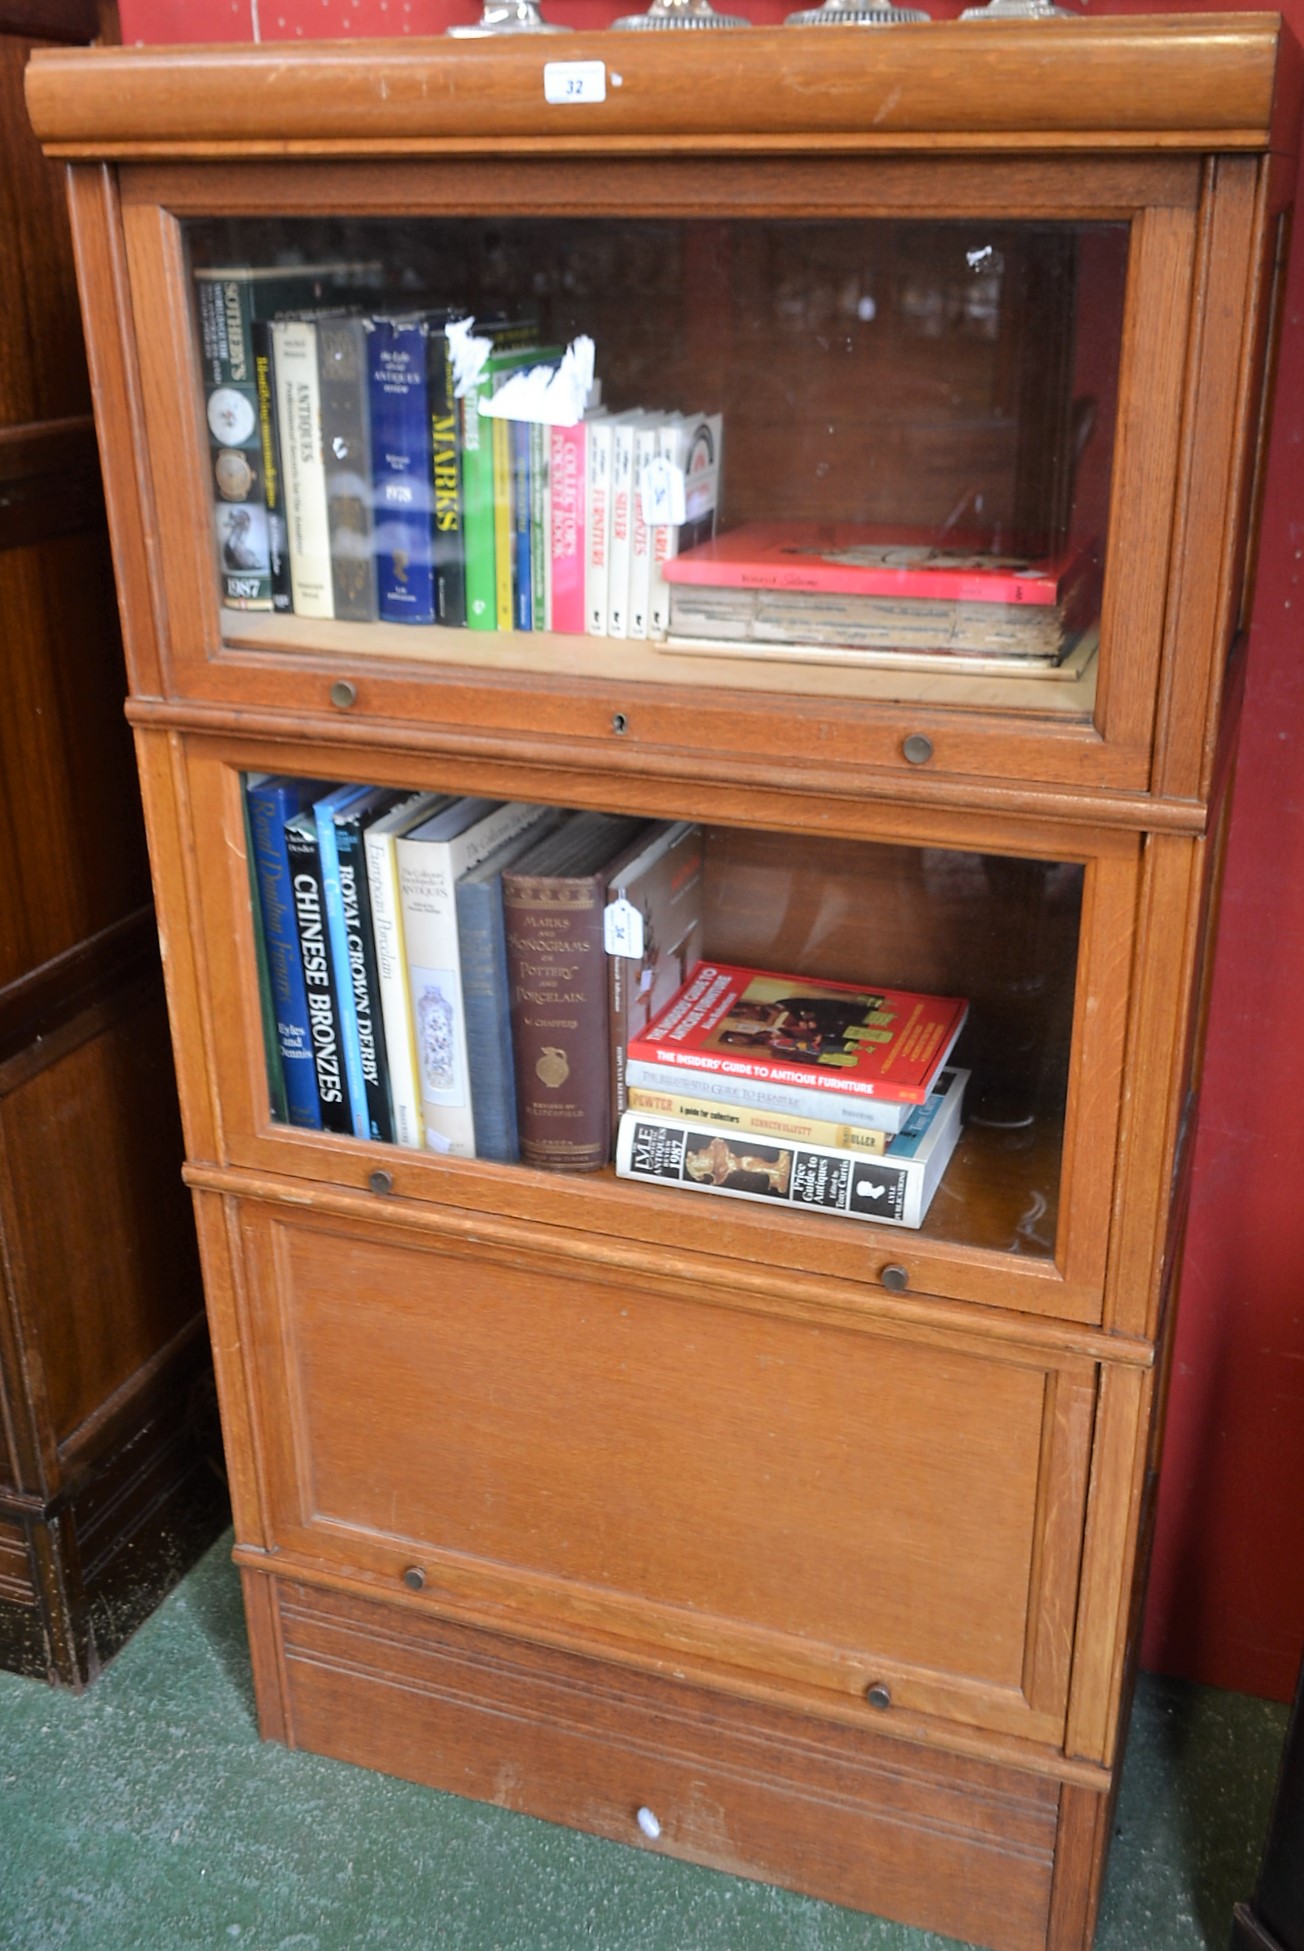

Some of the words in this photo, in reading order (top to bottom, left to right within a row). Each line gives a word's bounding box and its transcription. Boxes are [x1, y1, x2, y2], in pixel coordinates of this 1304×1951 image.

[566, 79, 583, 94] 32
[374, 371, 421, 385] ANTIQUES
[297, 381, 314, 464] ANTIQUES
[432, 413, 459, 532] MARKS
[386, 484, 412, 502] 1978
[591, 488, 606, 568] FURNITURE
[614, 491, 628, 541] SILVER
[228, 577, 261, 598] 1987
[367, 841, 386, 917] European
[260, 859, 288, 935] Doulton
[338, 864, 358, 936] ROYAL
[293, 873, 329, 987] CHINESE
[523, 916, 570, 928] MARKS
[615, 925, 625, 939] 34
[374, 918, 394, 980] Porcelain
[508, 934, 591, 952] MONOGRAMS
[348, 934, 369, 1015] CROWN
[520, 961, 579, 980] POTTERY
[698, 967, 718, 982] TO
[516, 986, 588, 1005] PORCELAIN
[306, 992, 342, 1104] BRONZES
[356, 1016, 378, 1086] DERBY
[656, 1049, 676, 1063] THE
[676, 1053, 721, 1070] INSIDERS'
[721, 1060, 753, 1075] GUIDE
[752, 1065, 769, 1077] TO
[770, 1068, 818, 1086] ANTIQUE
[818, 1076, 875, 1094] FURNITURE
[711, 1083, 741, 1097] GUIDE
[742, 1088, 757, 1100] TO
[632, 1092, 673, 1112] PEWTER
[680, 1105, 685, 1114] A
[685, 1107, 700, 1117] guide
[700, 1109, 710, 1118] for
[710, 1112, 740, 1124] collectors
[634, 1127, 653, 1170] LYLE
[653, 1127, 667, 1176] ANTIQUES
[662, 1139, 671, 1168] REVIEW
[669, 1139, 683, 1169] 1987
[807, 1156, 818, 1169] to
[793, 1162, 806, 1192] Price
[801, 1169, 816, 1202] Guide
[813, 1159, 829, 1204] Antiques
[829, 1178, 838, 1200] Edited
[837, 1160, 850, 1188] Curtis
[835, 1189, 846, 1209] Tony
[887, 1184, 896, 1205] LYLE
[893, 1170, 906, 1220] PUBLICATIONS
